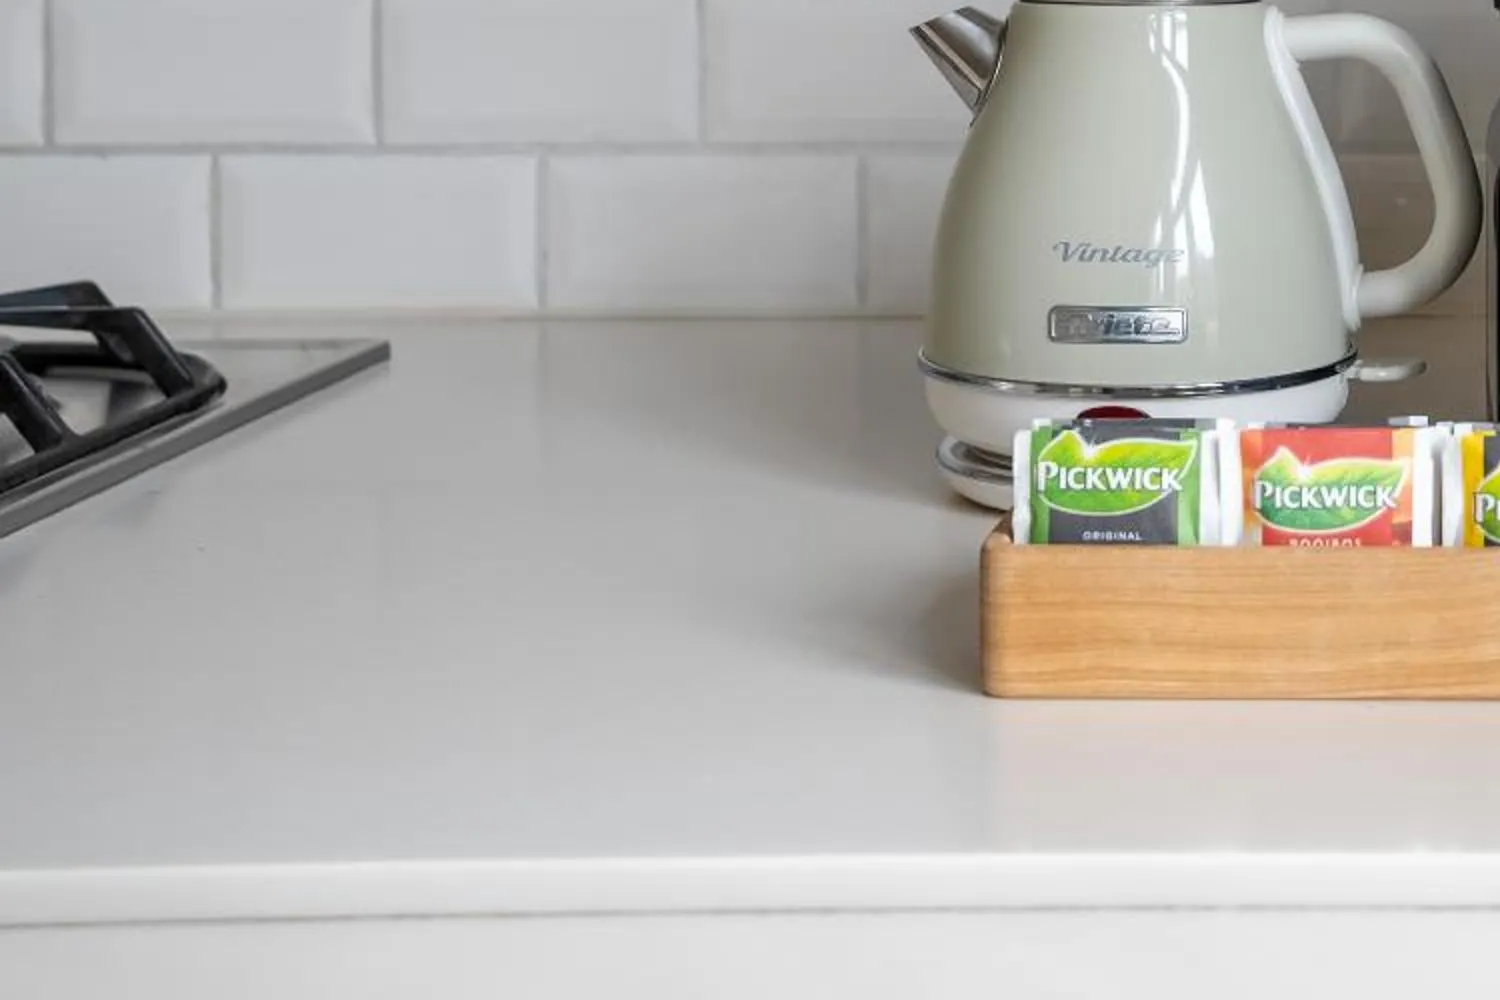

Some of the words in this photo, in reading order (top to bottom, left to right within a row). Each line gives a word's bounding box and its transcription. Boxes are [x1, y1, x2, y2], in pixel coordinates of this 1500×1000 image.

[1052, 241, 1184, 268] Vintage
[1036, 461, 1183, 491] PICKWICK
[1255, 480, 1396, 509] PICKWICK
[1082, 530, 1143, 541] ORIGINAL
